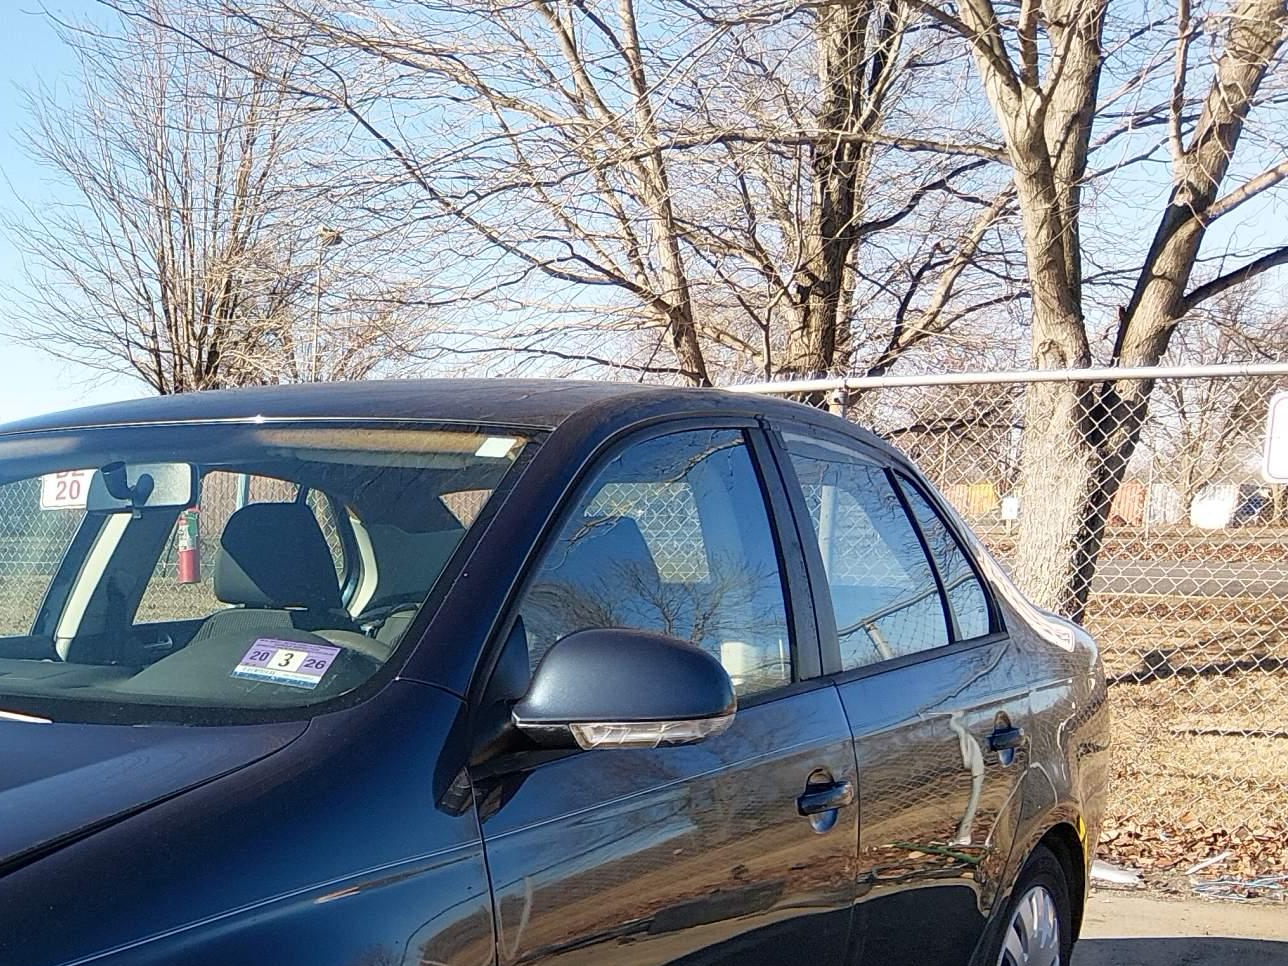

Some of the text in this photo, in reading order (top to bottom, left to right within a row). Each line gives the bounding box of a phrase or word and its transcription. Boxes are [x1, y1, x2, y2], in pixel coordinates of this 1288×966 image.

[55, 479, 81, 501] 20
[249, 650, 327, 670] 20 3 26
